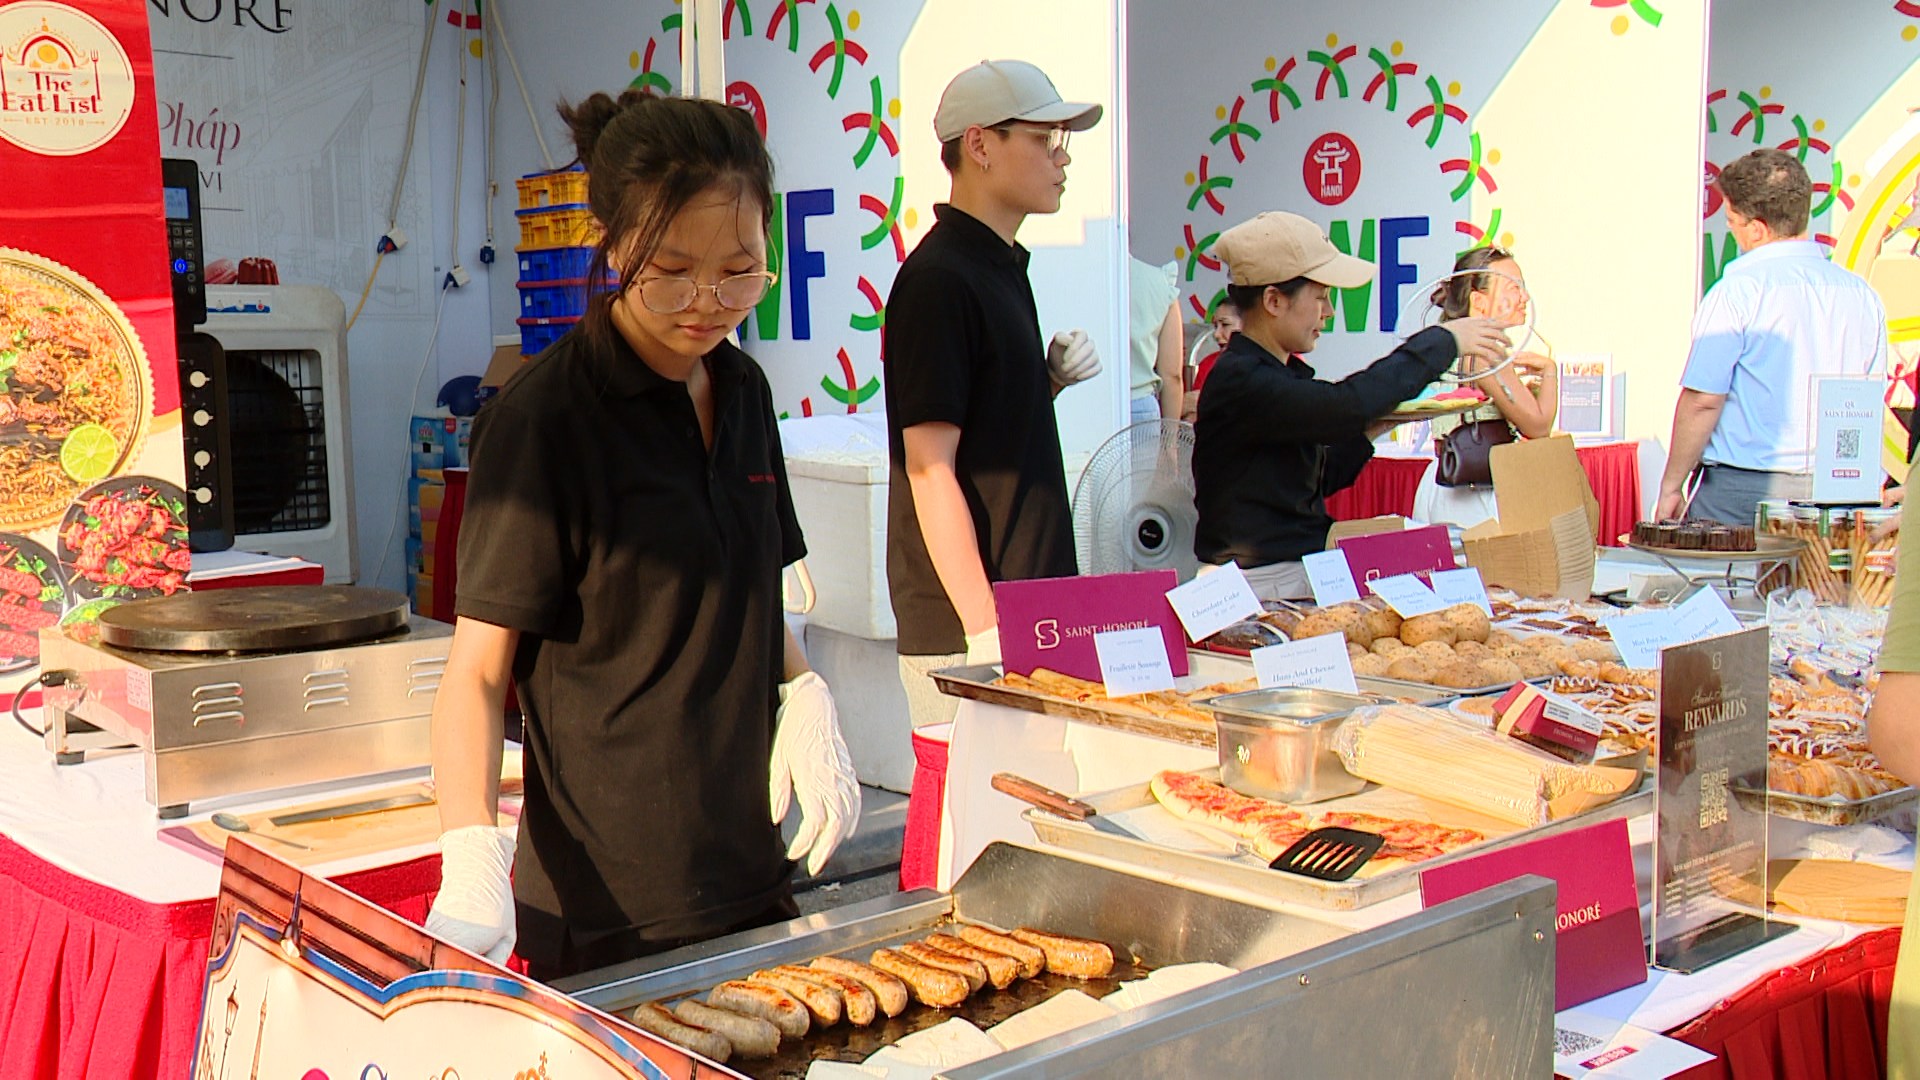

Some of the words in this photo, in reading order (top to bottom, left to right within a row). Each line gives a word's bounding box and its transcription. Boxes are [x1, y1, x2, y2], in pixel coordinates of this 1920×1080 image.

[27, 71, 73, 92] The
[1, 91, 49, 112] Eat
[53, 93, 103, 114] List
[1320, 184, 1343, 198] HANOI
[1192, 599, 1223, 618] Chocolate
[1223, 591, 1240, 602] Cake
[1272, 674, 1291, 683] Ham
[1292, 668, 1308, 679] And
[1309, 664, 1336, 675] Cheese
[1684, 697, 1747, 732] REWARDS
